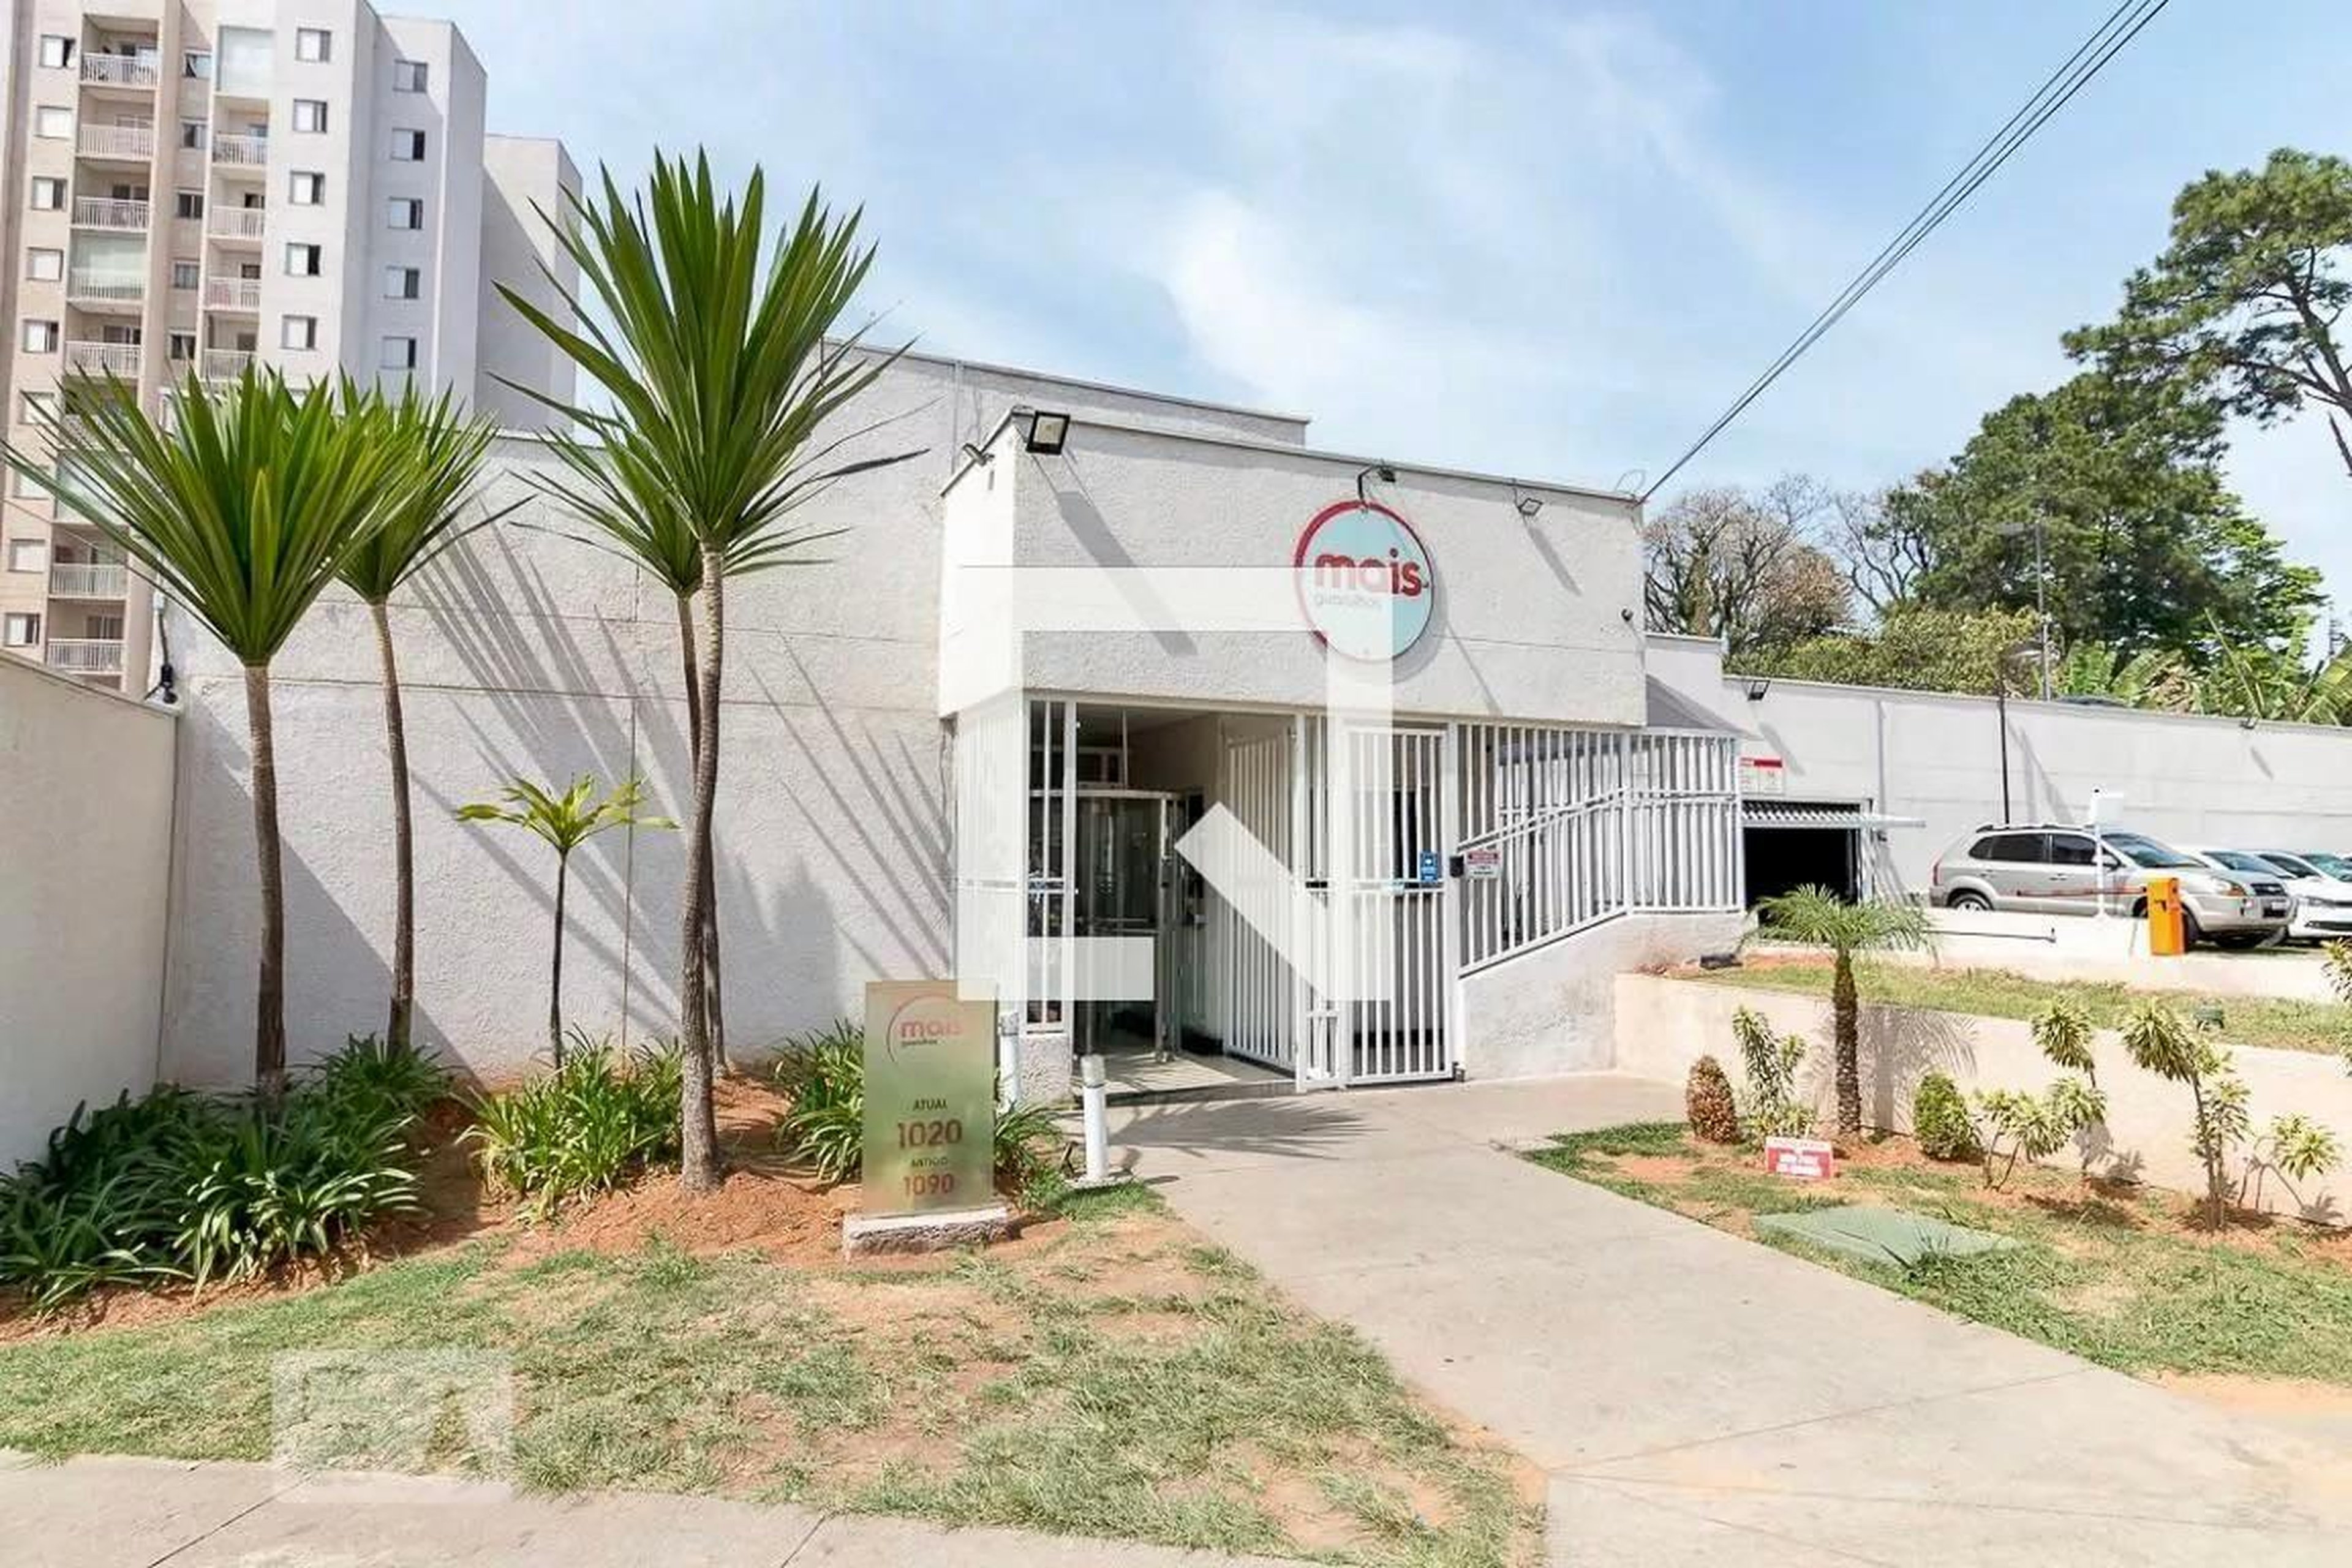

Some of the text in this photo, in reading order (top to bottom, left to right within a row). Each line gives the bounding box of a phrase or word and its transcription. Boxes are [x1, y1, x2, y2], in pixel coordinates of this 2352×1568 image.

[1314, 547, 1422, 597] mais
[901, 1020, 963, 1038] mais
[912, 1098, 948, 1111] ATUAL
[897, 1118, 962, 1150] 1020
[903, 1173, 954, 1197] 1090
